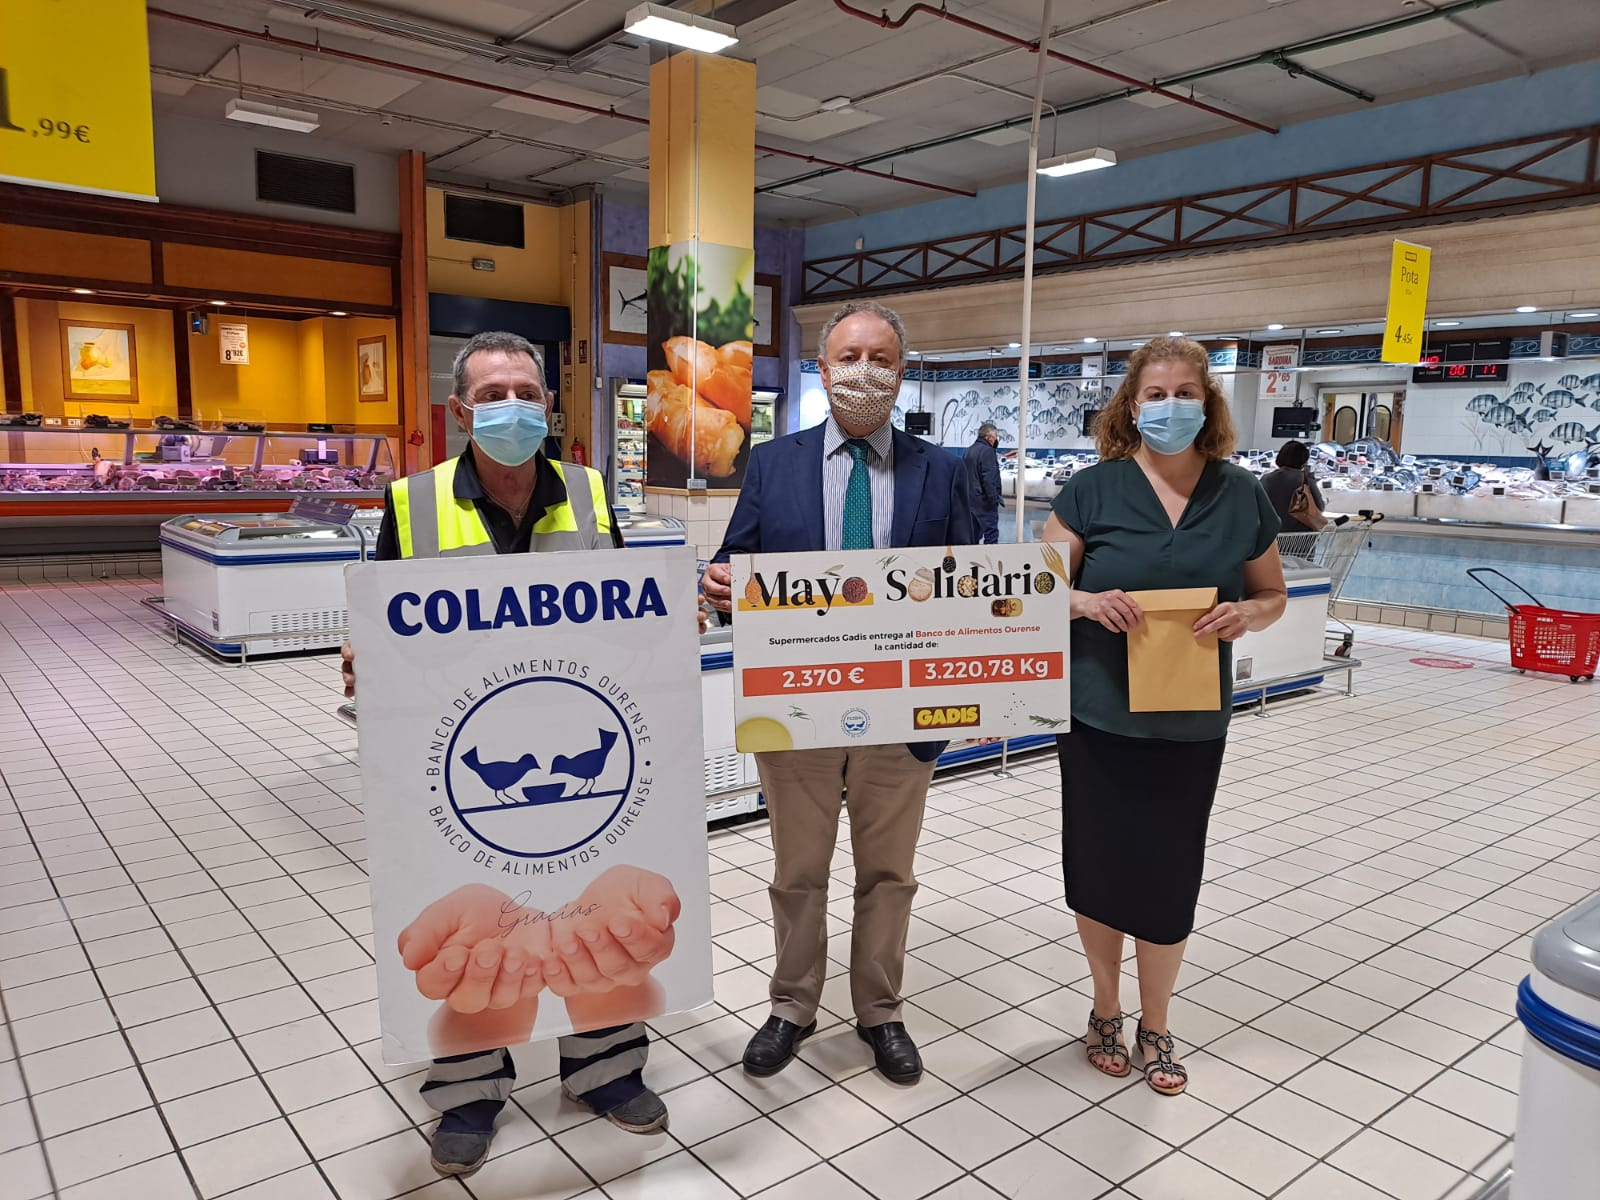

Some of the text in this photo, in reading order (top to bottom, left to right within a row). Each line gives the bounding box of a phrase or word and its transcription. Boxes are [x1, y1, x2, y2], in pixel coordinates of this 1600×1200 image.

[1401, 266, 1419, 285] Pota
[886, 562, 1056, 603] Solidario
[387, 576, 668, 637] COLABORA
[768, 624, 1041, 646] Supermercados Gadis entrega al Banco de Alimentos Ourense
[874, 640, 939, 651] la cantidad de:
[782, 666, 865, 688] 2.370 €
[924, 657, 1049, 681] 3.220,78 Kg
[426, 659, 651, 776] BANCO DE ALIMENTOS OURENSE
[917, 706, 978, 726] GADIS
[429, 776, 653, 876] BANCO DE ALIMENTOS OURENSE
[497, 890, 601, 938] Gracias
